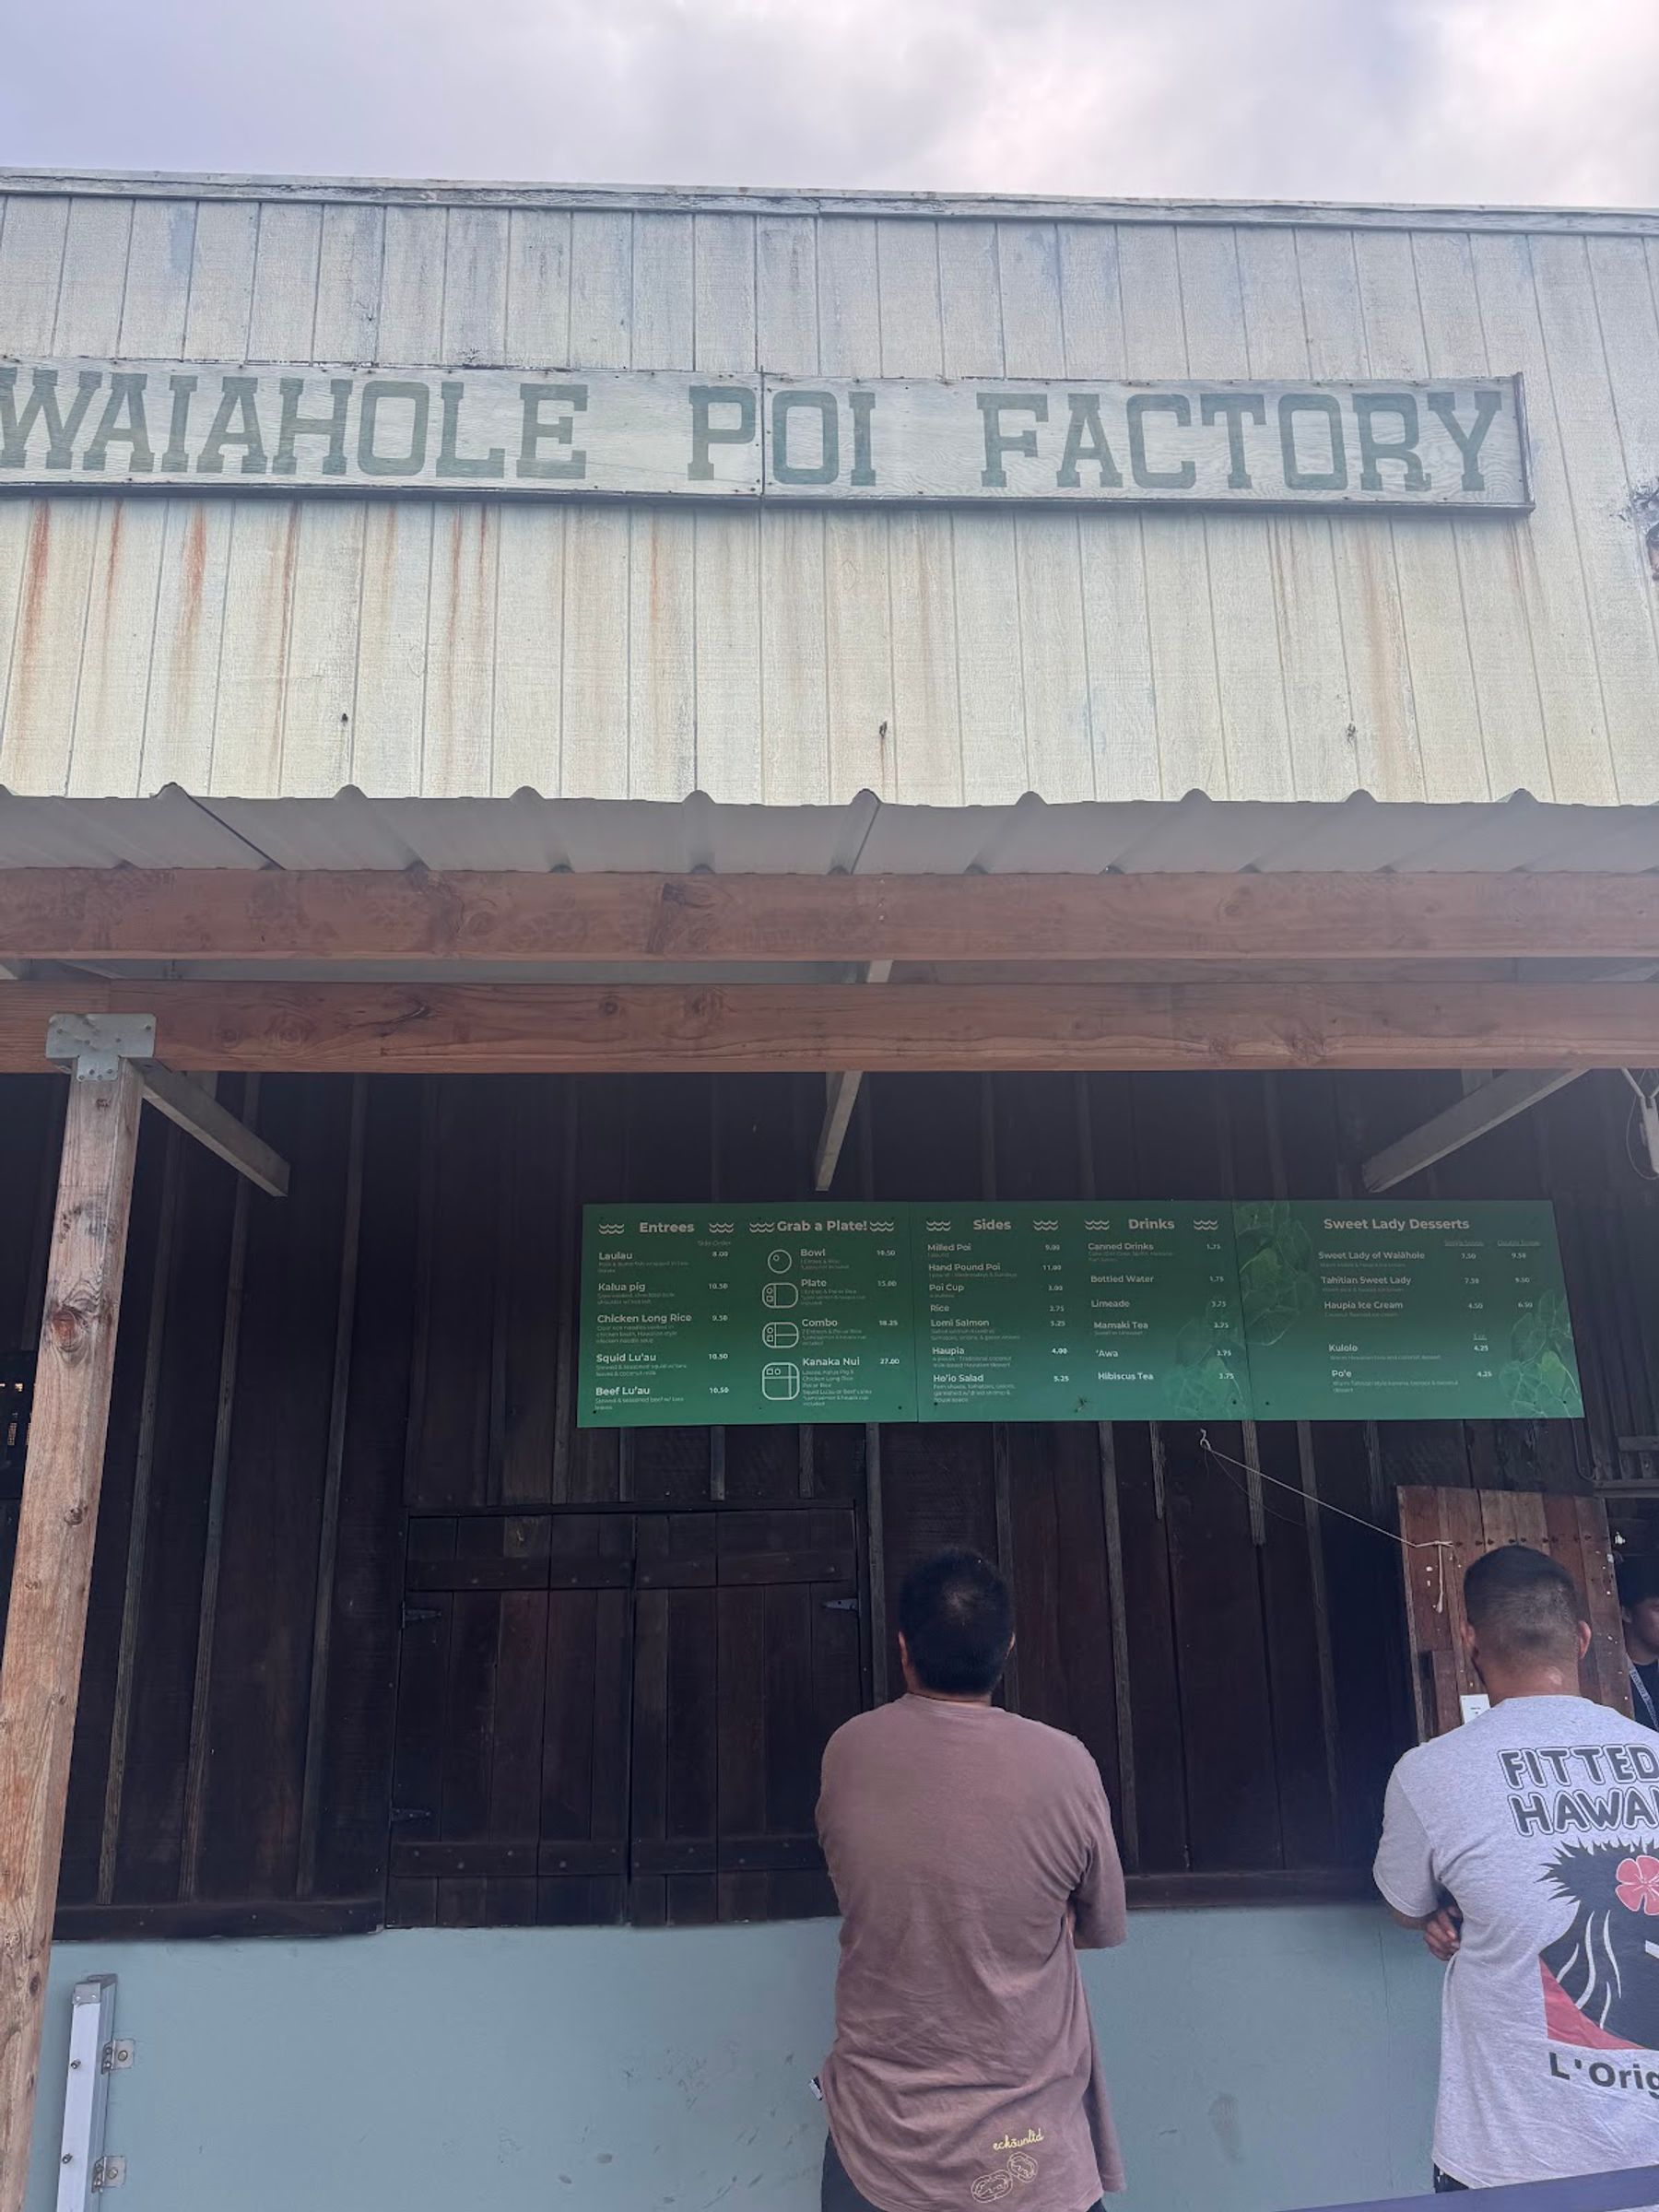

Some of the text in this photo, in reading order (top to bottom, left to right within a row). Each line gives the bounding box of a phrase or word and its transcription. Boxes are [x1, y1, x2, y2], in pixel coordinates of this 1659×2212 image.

[0, 369, 1502, 491] WAIAHOLE POI FACTORY
[639, 1222, 695, 1233] Entrees
[777, 1220, 867, 1232] Grab a Plate!
[972, 1218, 1012, 1230] Sides
[1128, 1218, 1175, 1230] Drinks
[1324, 1218, 1470, 1232] Sweet Lady Desserts
[927, 1242, 971, 1252] Milled Poi
[1088, 1242, 1154, 1251] Canned Drinks
[598, 1251, 633, 1261] Laulau
[800, 1248, 826, 1258] Bowl
[1318, 1252, 1347, 1260] Sweet
[1348, 1252, 1369, 1261] Lady
[1371, 1252, 1381, 1260] of
[928, 1263, 1001, 1272] Hand Pound Poi
[801, 1278, 828, 1288] Plate
[1090, 1275, 1155, 1283] Bottled Water
[1321, 1277, 1412, 1286] Tahitian Sweet Lady
[598, 1281, 646, 1294] Kalua pig
[708, 1282, 729, 1290] 10.50
[929, 1283, 965, 1293] Poi Cup
[930, 1303, 950, 1312] Rice
[1090, 1300, 1131, 1309] Limeade
[1324, 1301, 1404, 1310] Haupia Ice Cream
[597, 1312, 693, 1325] Chicken Long Rice
[801, 1318, 839, 1328] Combo
[930, 1318, 990, 1327] Lomi Salmon
[1093, 1321, 1149, 1330] Mamaki Tea
[932, 1347, 965, 1358] Haupia
[1328, 1344, 1358, 1353] Kulolo
[595, 1352, 626, 1364] Squid
[802, 1357, 861, 1367] Kanaka Nui
[959, 1373, 984, 1382] Salad
[1098, 1371, 1154, 1381] Hibiscus Tea
[595, 1386, 620, 1396] Beef
[709, 1386, 730, 1394] 10.50
[1498, 1743, 1659, 1789] FITTED
[1549, 2052, 1659, 2100] L'Orig
